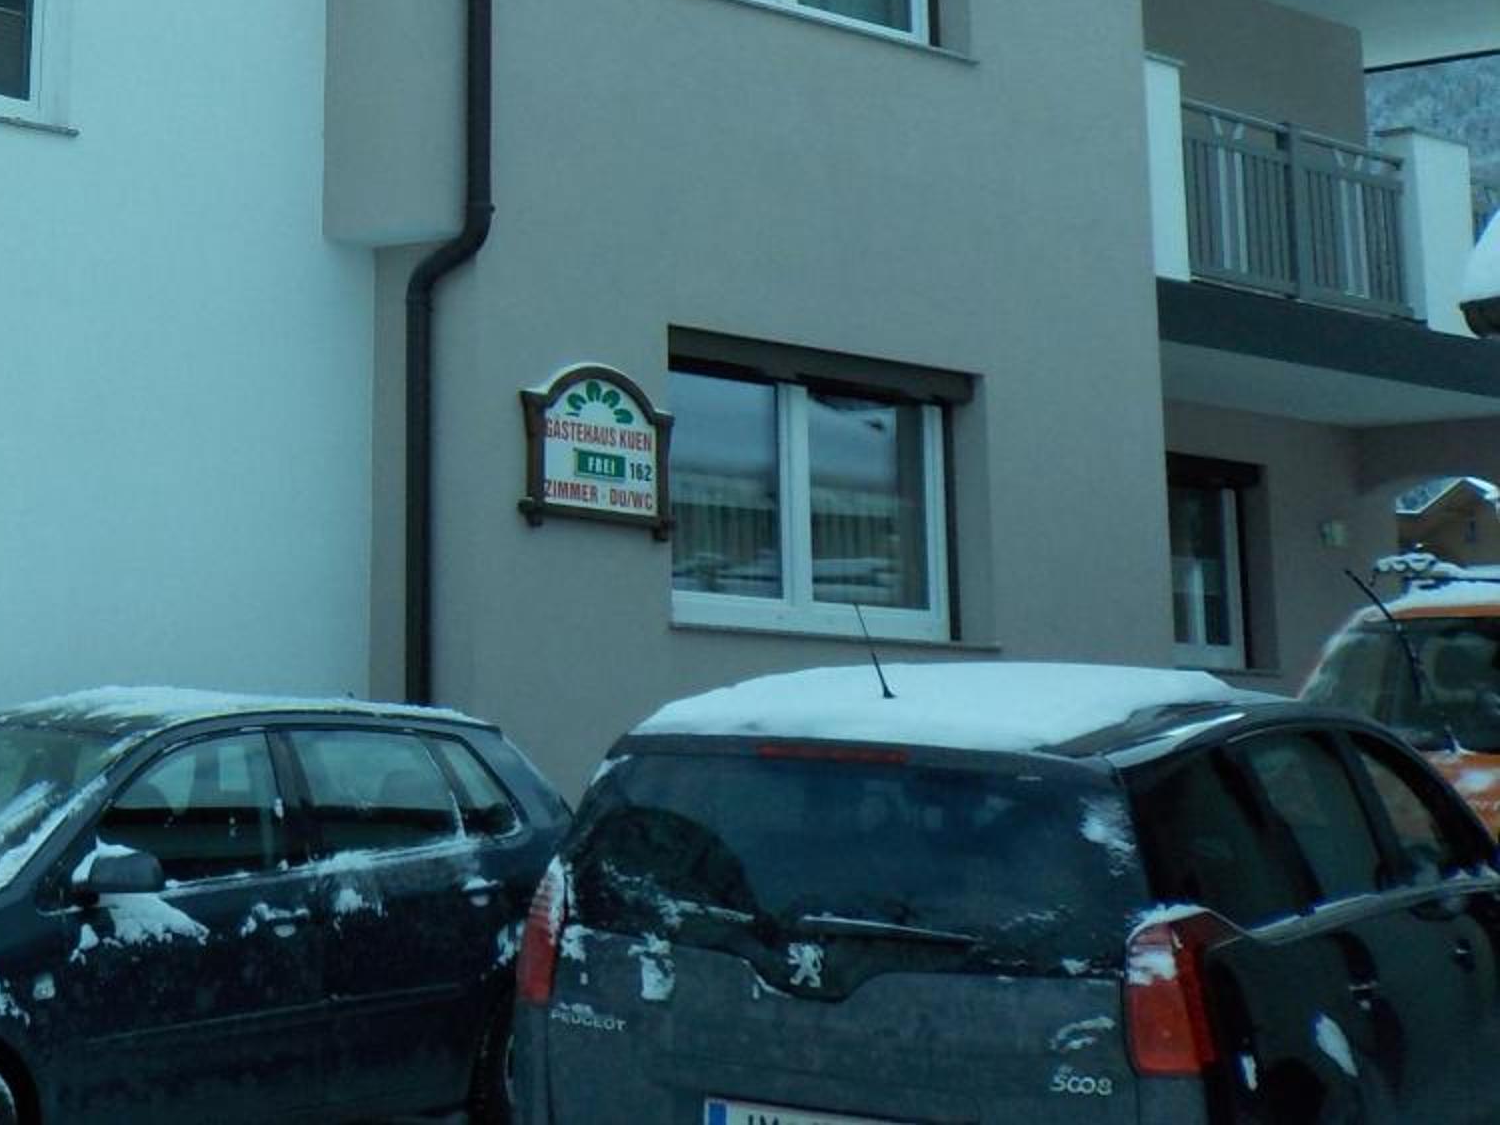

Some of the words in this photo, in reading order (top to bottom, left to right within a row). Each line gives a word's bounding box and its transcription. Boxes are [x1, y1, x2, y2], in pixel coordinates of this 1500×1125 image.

[619, 428, 652, 451] KUEN
[629, 462, 653, 482] 162
[545, 479, 598, 504] ZIMMER
[610, 488, 653, 510] DU/WC
[1049, 1074, 1113, 1095] 5008
